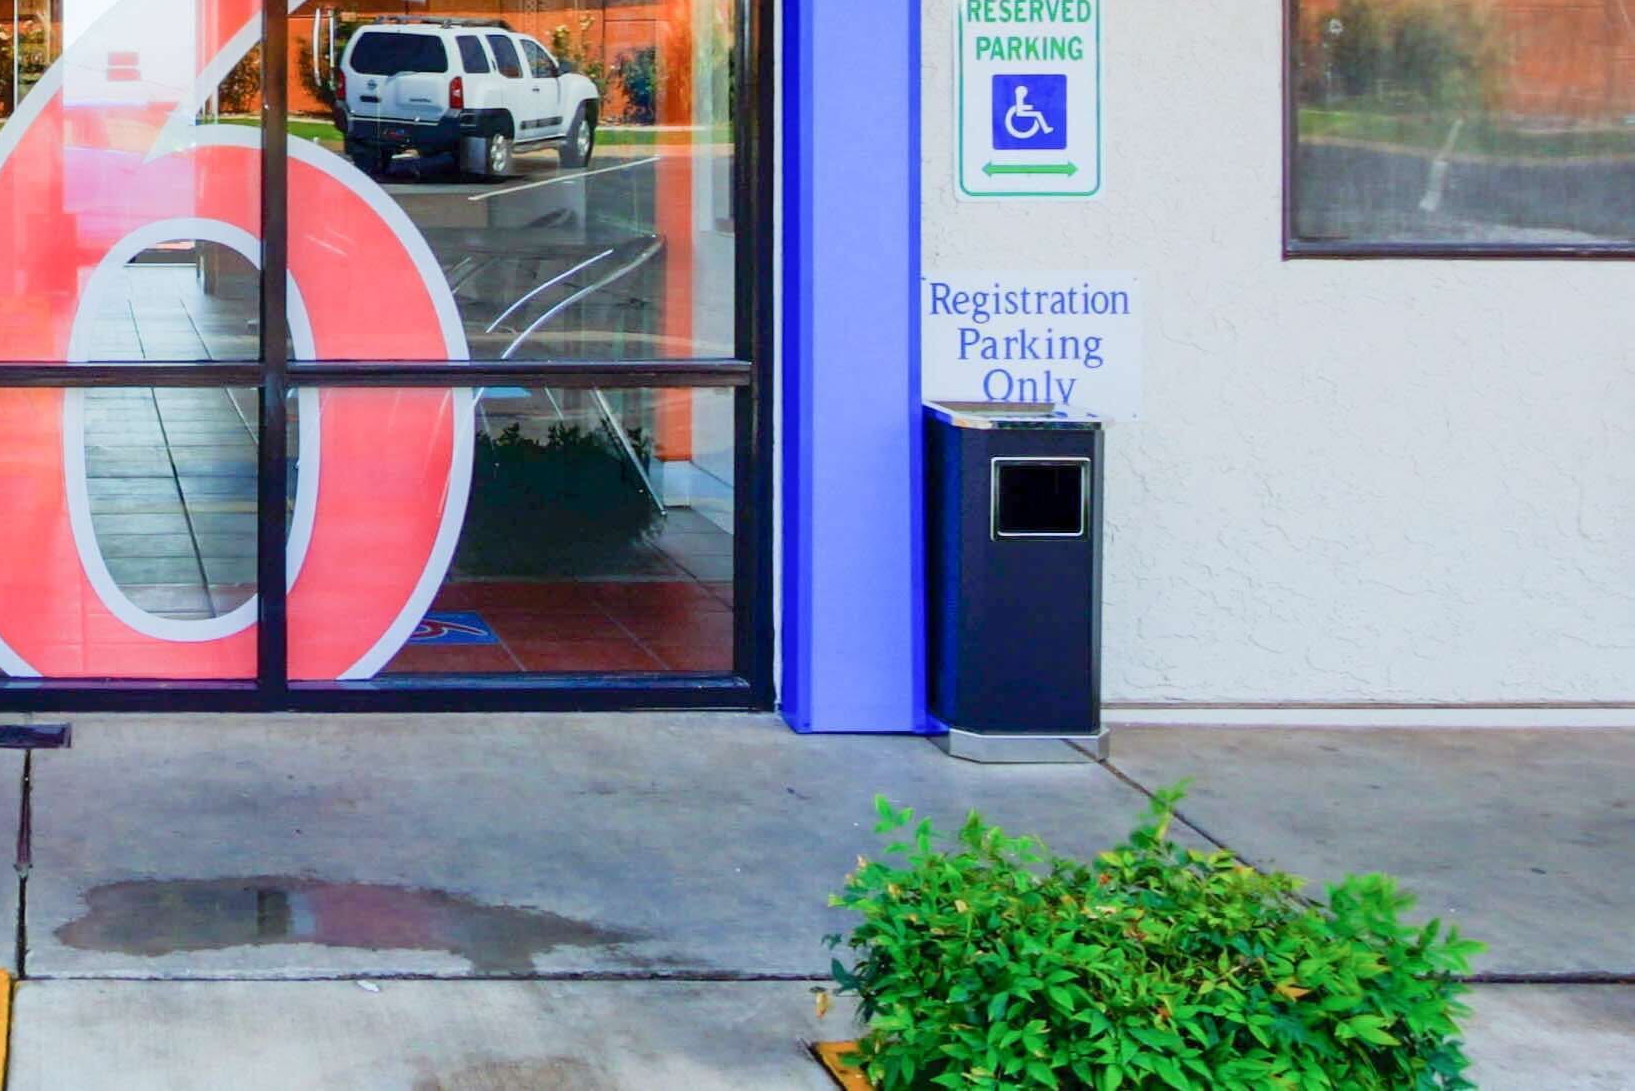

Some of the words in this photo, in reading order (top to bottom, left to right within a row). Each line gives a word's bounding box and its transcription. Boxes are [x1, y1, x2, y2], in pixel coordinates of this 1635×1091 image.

[975, 37, 1084, 62] PARKING
[929, 282, 1131, 324] Registration
[956, 327, 1104, 369] Parking
[982, 369, 1077, 404] Only
